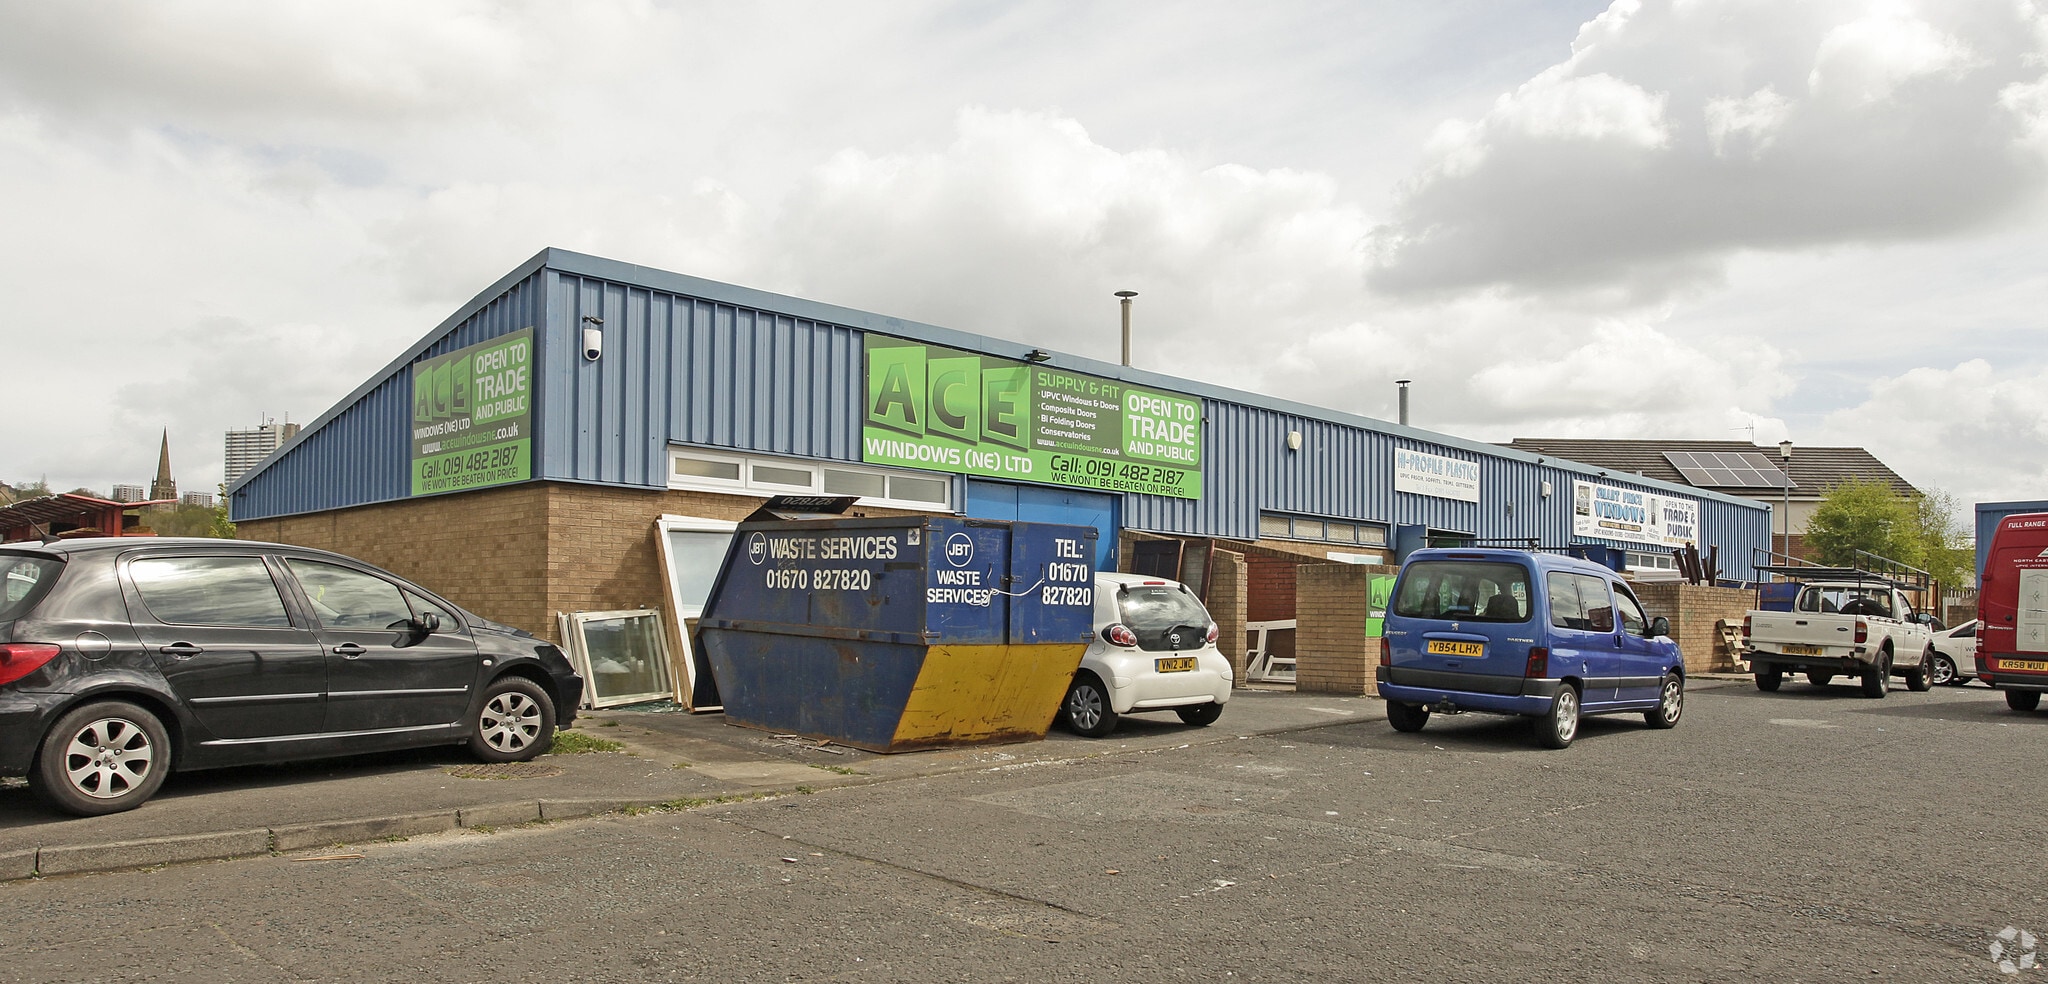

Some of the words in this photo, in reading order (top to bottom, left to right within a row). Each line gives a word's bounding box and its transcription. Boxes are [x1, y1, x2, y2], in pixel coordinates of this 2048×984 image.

[476, 349, 507, 374] OPEN
[510, 342, 526, 365] TO
[416, 368, 465, 417] ACE
[476, 366, 526, 401] TRADE
[1038, 372, 1087, 393] SUPPLY
[1089, 382, 1099, 395] &
[1102, 385, 1120, 399] FIT
[476, 406, 494, 420] AND
[495, 395, 525, 416] PUBLIC
[873, 362, 1019, 439] ACE
[1041, 390, 1061, 401] UPVC
[1062, 393, 1093, 406] Windows
[1093, 399, 1099, 407] &
[1100, 400, 1120, 411] Doors
[1041, 403, 1076, 417] Composite
[1077, 408, 1097, 419] Doors
[1128, 394, 1171, 417] OPEN
[1174, 403, 1195, 422] TO
[414, 423, 444, 440] WINDOWS
[444, 419, 458, 435] (NE)
[459, 417, 470, 430] LTD
[1041, 426, 1091, 441] Conservatories
[1049, 416, 1075, 428] Folding
[1075, 419, 1096, 430] Doors
[1128, 414, 1195, 446] TRADE
[422, 421, 519, 454] www.acewindowsne.co.uk
[1037, 438, 1120, 456] www.acewindowsne.co.uk
[866, 438, 960, 465] WINDOWS
[965, 450, 1000, 472] (NE)
[1005, 455, 1033, 474] LTD
[1128, 440, 1154, 455] AND
[1156, 446, 1195, 462] PUBLIC
[422, 459, 441, 480] Call:
[443, 454, 464, 476] 0191
[466, 449, 489, 470] 482
[491, 445, 518, 467] 2187
[1051, 455, 1081, 473] Call:
[1086, 460, 1116, 478] 0191
[1119, 464, 1150, 482] 482
[1153, 468, 1185, 485] 2187
[1397, 451, 1443, 476] HI-PROFILE
[1445, 460, 1478, 481] PLASTICS
[422, 480, 431, 491] WE
[432, 477, 452, 490] WON'T
[453, 476, 460, 487] BE
[462, 472, 484, 485] BEATEN
[486, 471, 496, 482] ON
[497, 468, 519, 480] PRICE!
[1051, 472, 1066, 483] WE
[1069, 474, 1098, 487] WON'T
[1100, 478, 1111, 488] BE
[1113, 479, 1145, 492] BEATEN
[1147, 484, 1158, 493] ON
[1160, 485, 1185, 496] PRICE!
[1594, 500, 1645, 524] WINDOWS
[1665, 500, 1678, 508] OPEN
[1678, 502, 1685, 510] TO
[1663, 508, 1688, 523] TRADE
[1690, 512, 1695, 525] &
[1667, 523, 1693, 538] PUBLIC
[751, 542, 764, 555] JBT
[769, 538, 817, 559] WASTE
[821, 536, 898, 560] SERVICES
[948, 544, 971, 557] JBT
[1055, 538, 1084, 559] TEL:
[766, 569, 808, 589] 01670
[813, 569, 871, 591] 827820
[936, 570, 981, 586] WASTE
[1048, 562, 1088, 583] 01670
[927, 588, 989, 604] SERVICES
[1042, 586, 1091, 606] 827820
[1433, 642, 1456, 653] YB54
[1459, 644, 1479, 654] LHX
[1162, 660, 1178, 670] VN12
[1180, 659, 1193, 669] JWC
[2002, 661, 2025, 669] KR58
[2027, 662, 2045, 670] WUU
